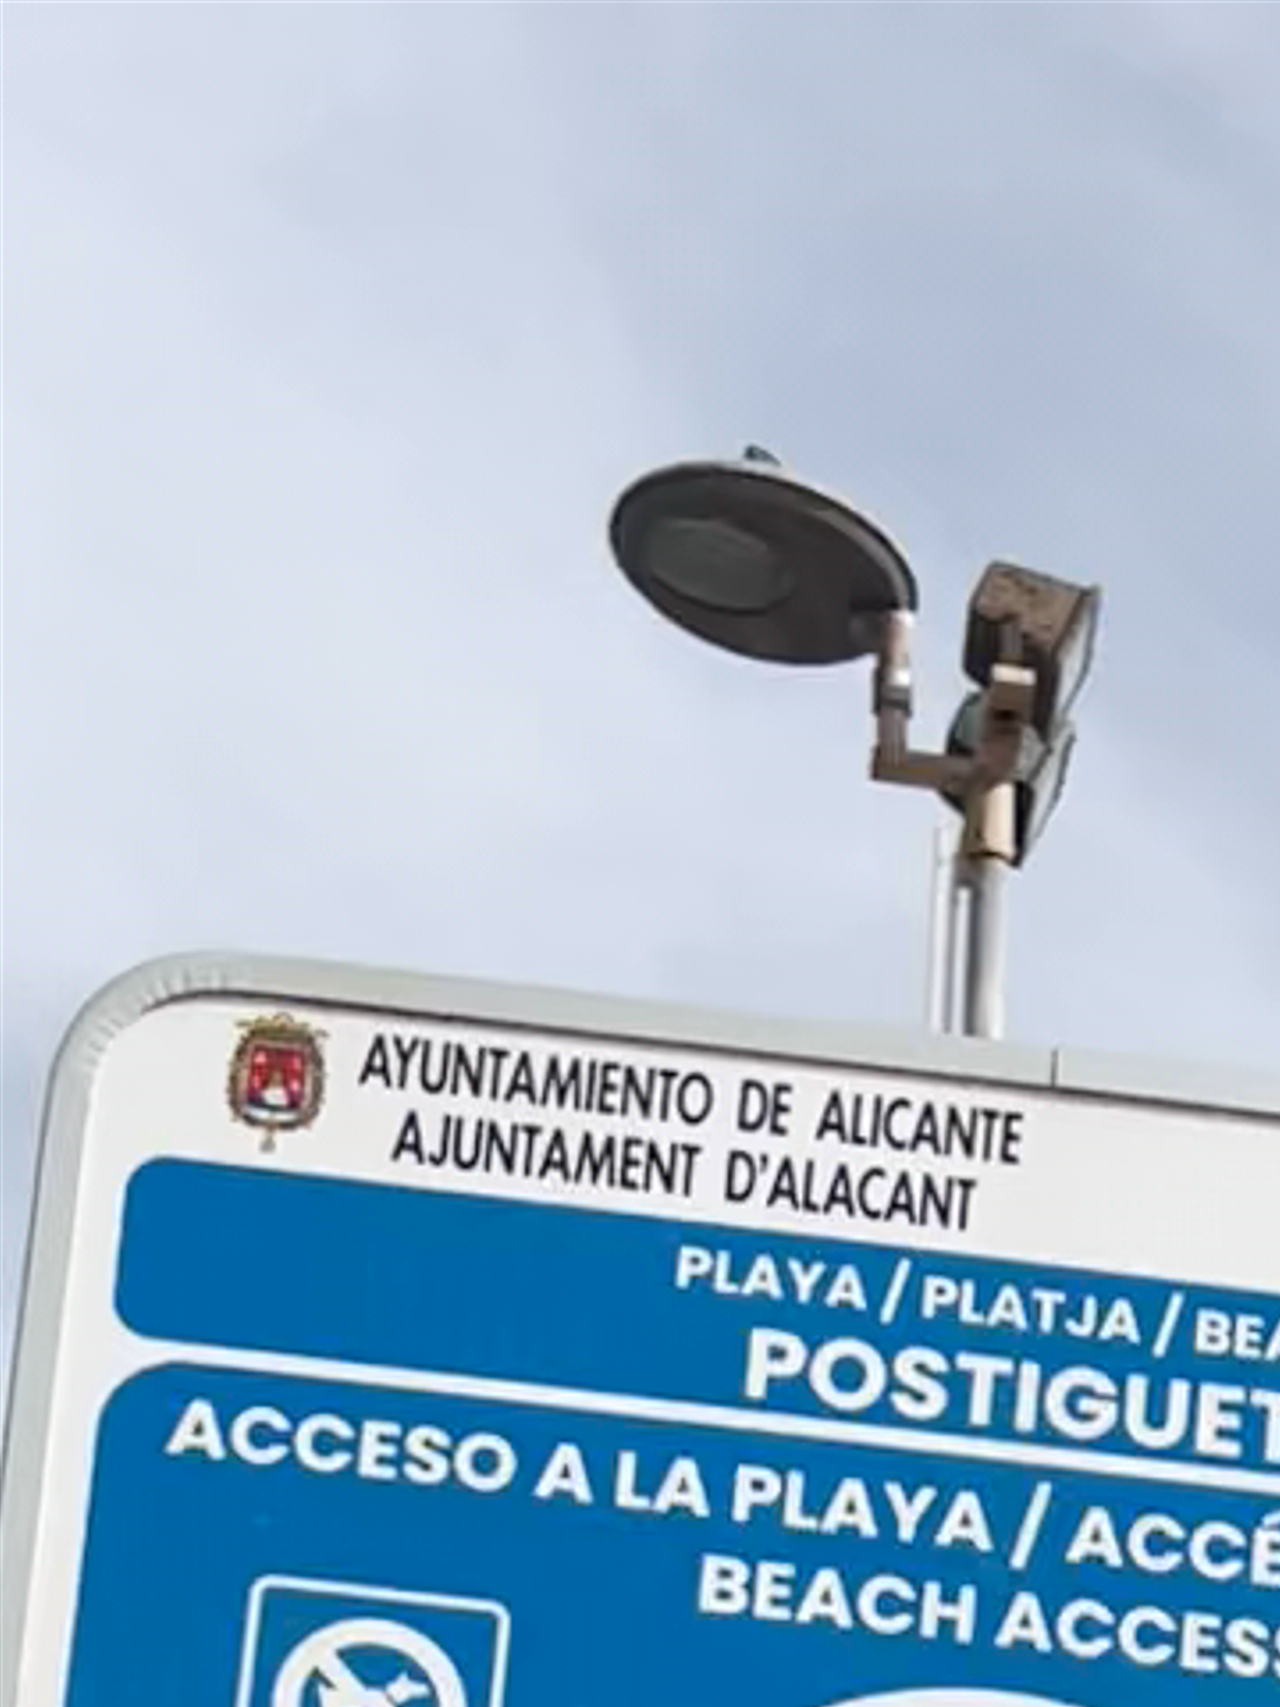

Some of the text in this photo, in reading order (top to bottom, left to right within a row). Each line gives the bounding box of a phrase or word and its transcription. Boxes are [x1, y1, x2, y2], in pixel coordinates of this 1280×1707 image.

[359, 1035, 1023, 1166] AYUNTAMIENTO DE ALICANTE
[391, 1111, 977, 1231] AJUNTAMENT D'ALACANT
[675, 1246, 867, 1313] PLAYA
[921, 1275, 1141, 1345] PLATJA
[166, 1399, 517, 1492] ACCESO
[534, 1444, 592, 1504] A
[613, 1452, 709, 1518] LA
[731, 1464, 993, 1552] PLAYA
[696, 1554, 976, 1645] BEACH
